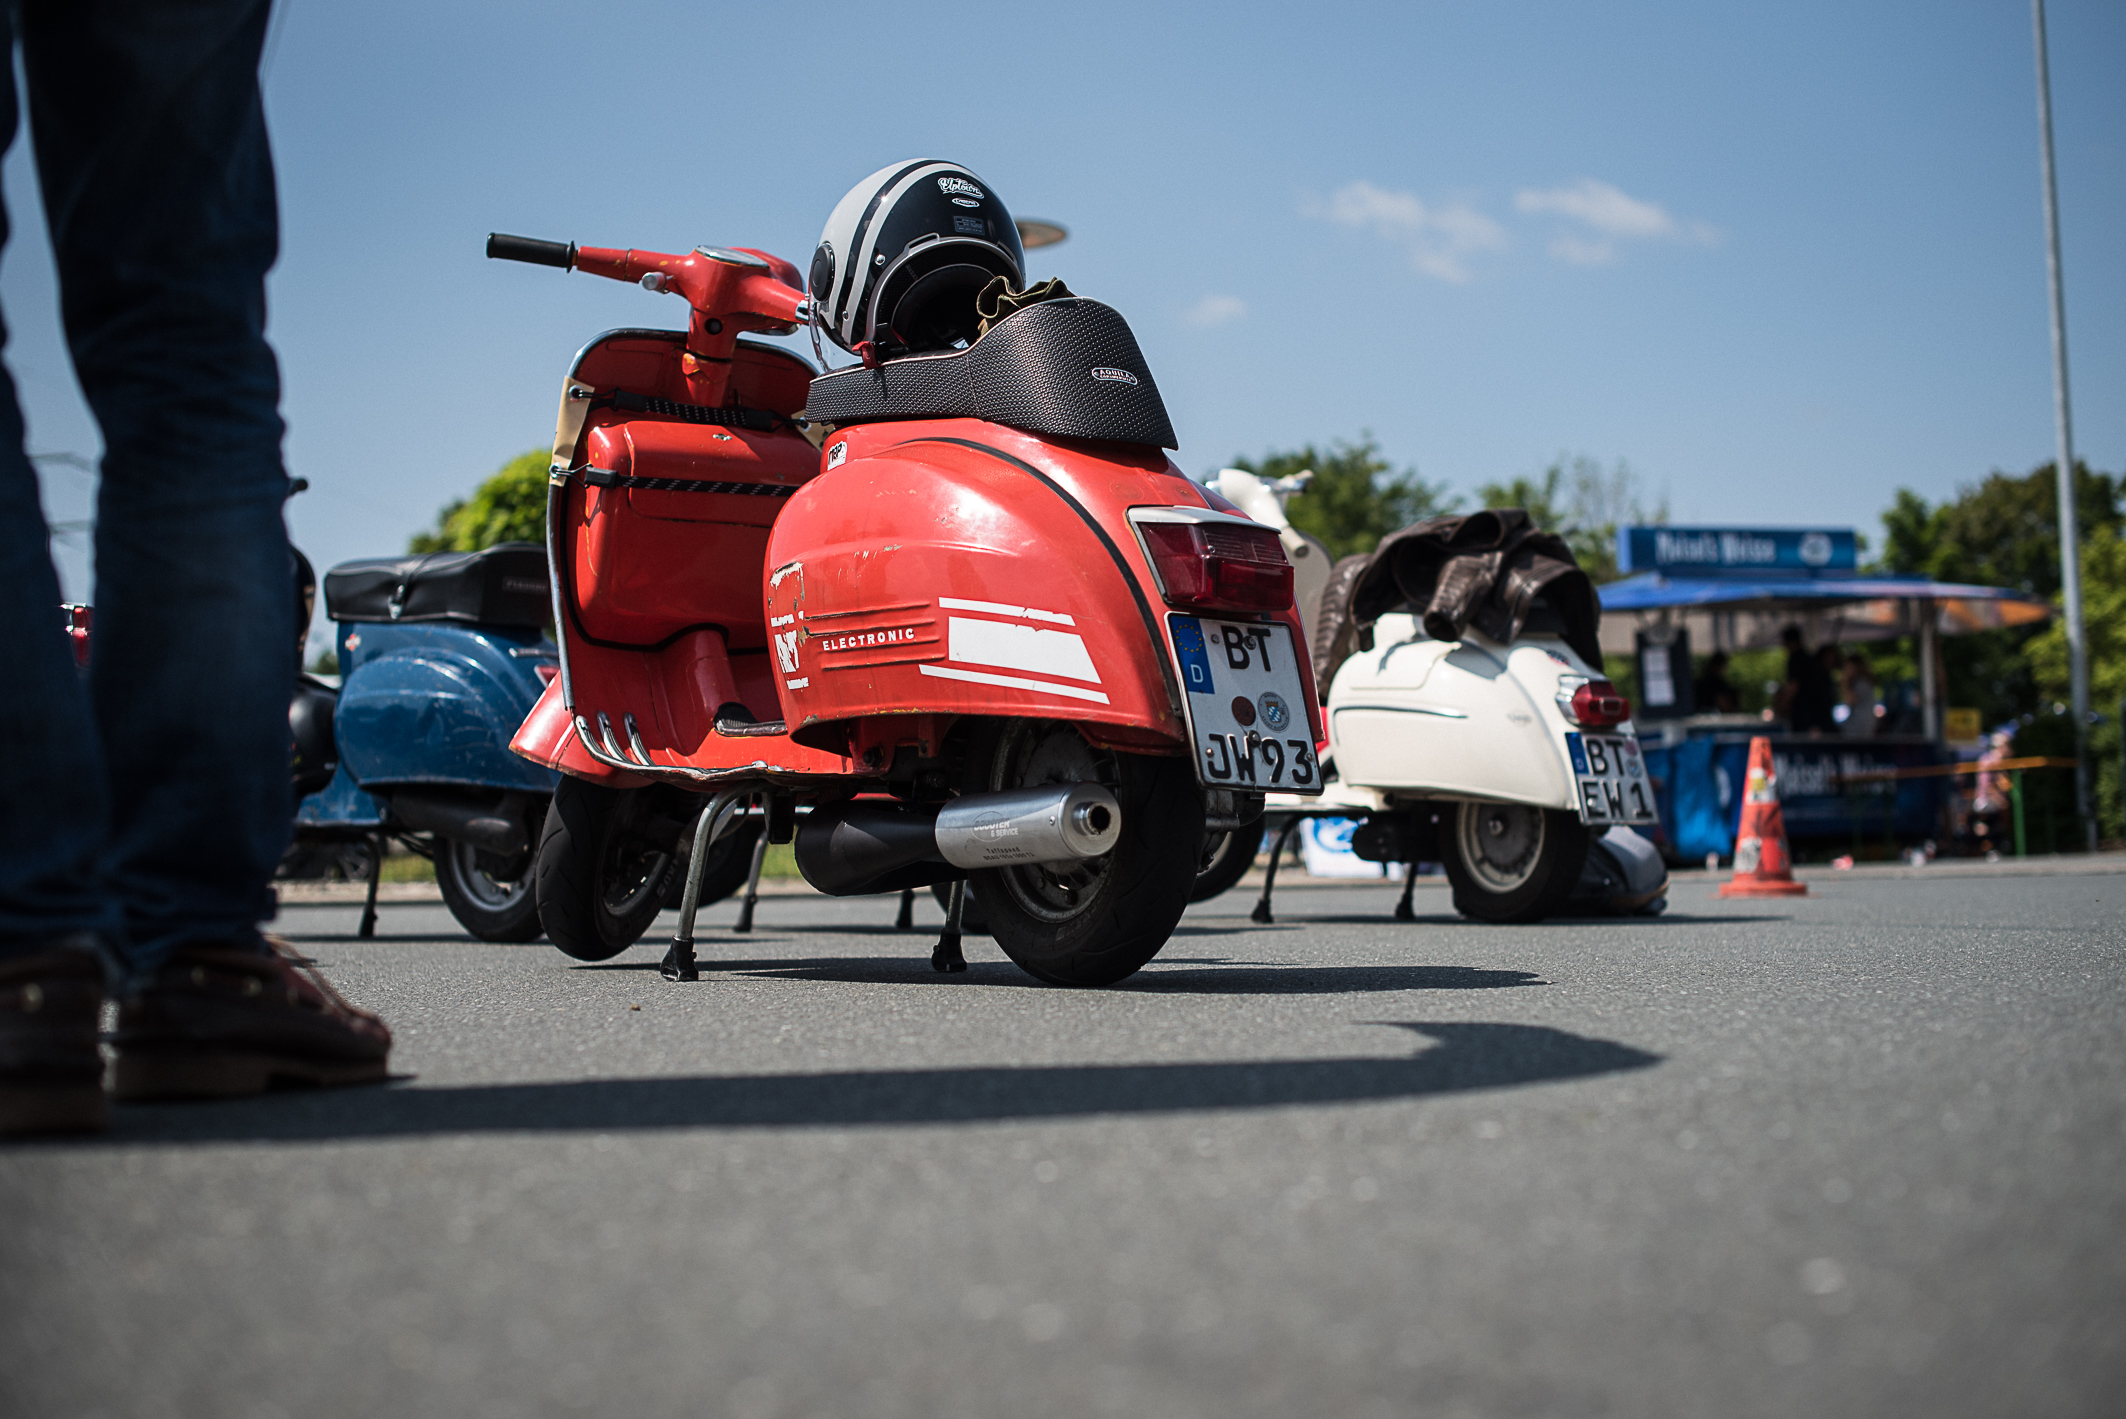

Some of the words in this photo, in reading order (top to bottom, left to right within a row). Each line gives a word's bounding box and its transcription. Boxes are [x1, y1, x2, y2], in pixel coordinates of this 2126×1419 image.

[1099, 369, 1131, 378] AQUILA
[822, 628, 915, 651] ELECTRONIC
[1221, 625, 1271, 672] BT
[1190, 664, 1204, 683] D
[1586, 739, 1625, 776] BT
[973, 817, 1011, 831] SCOOTER
[996, 828, 1019, 837] SERVICE
